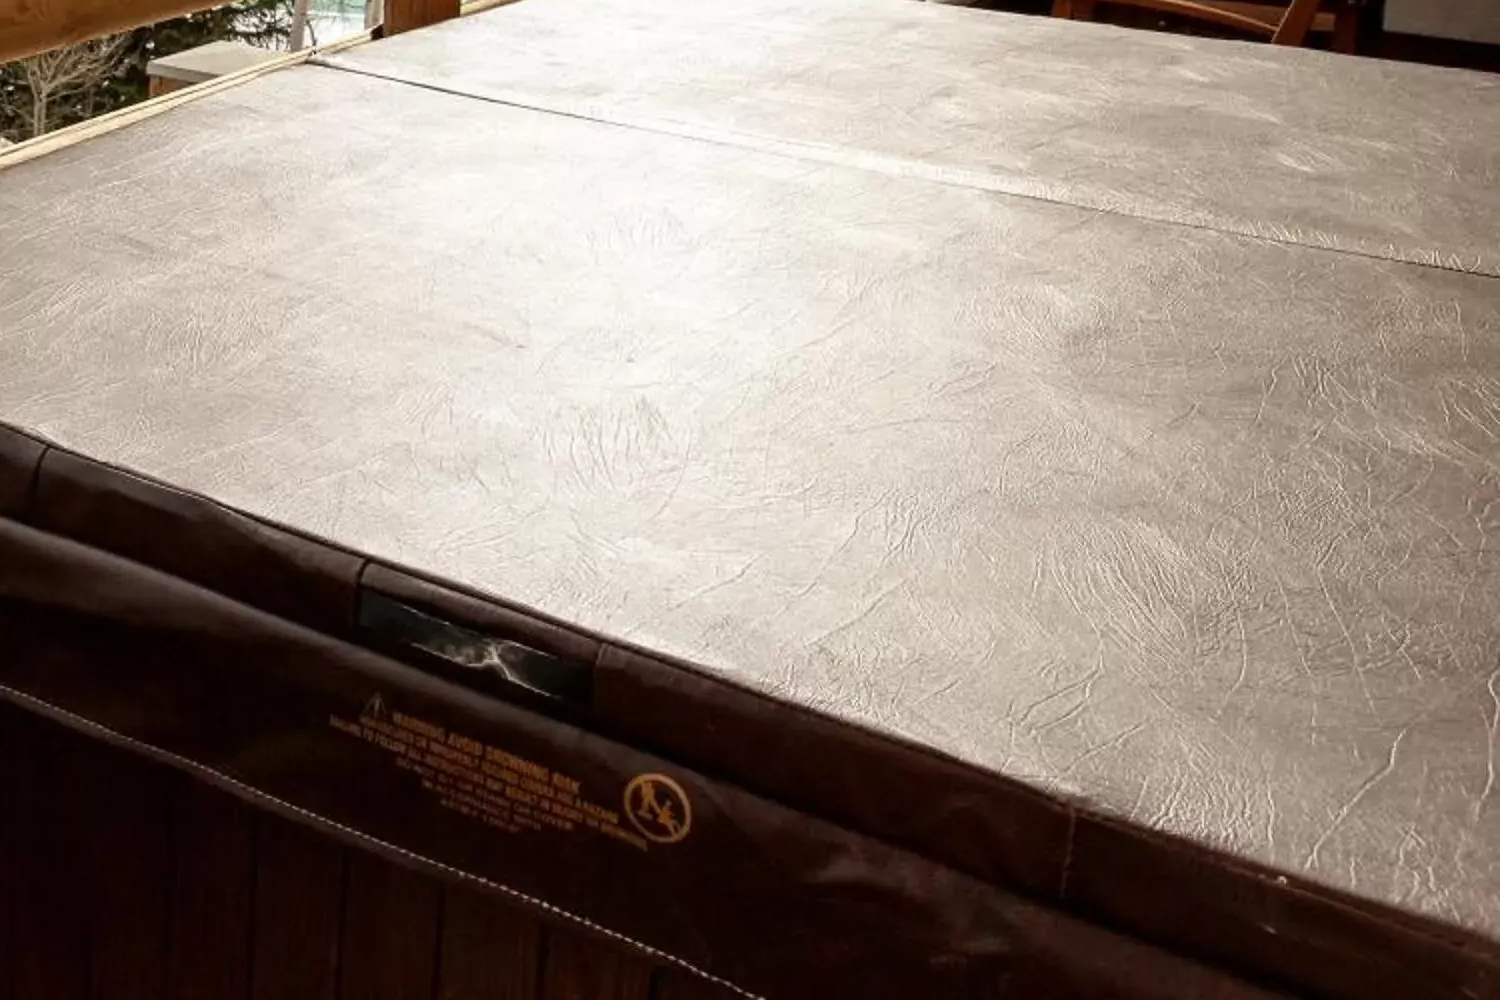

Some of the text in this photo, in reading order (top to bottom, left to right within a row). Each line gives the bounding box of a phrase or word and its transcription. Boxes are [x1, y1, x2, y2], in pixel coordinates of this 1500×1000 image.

[393, 710, 444, 742] WARNING
[447, 731, 482, 757] AVOID
[484, 745, 548, 782] DROWNING
